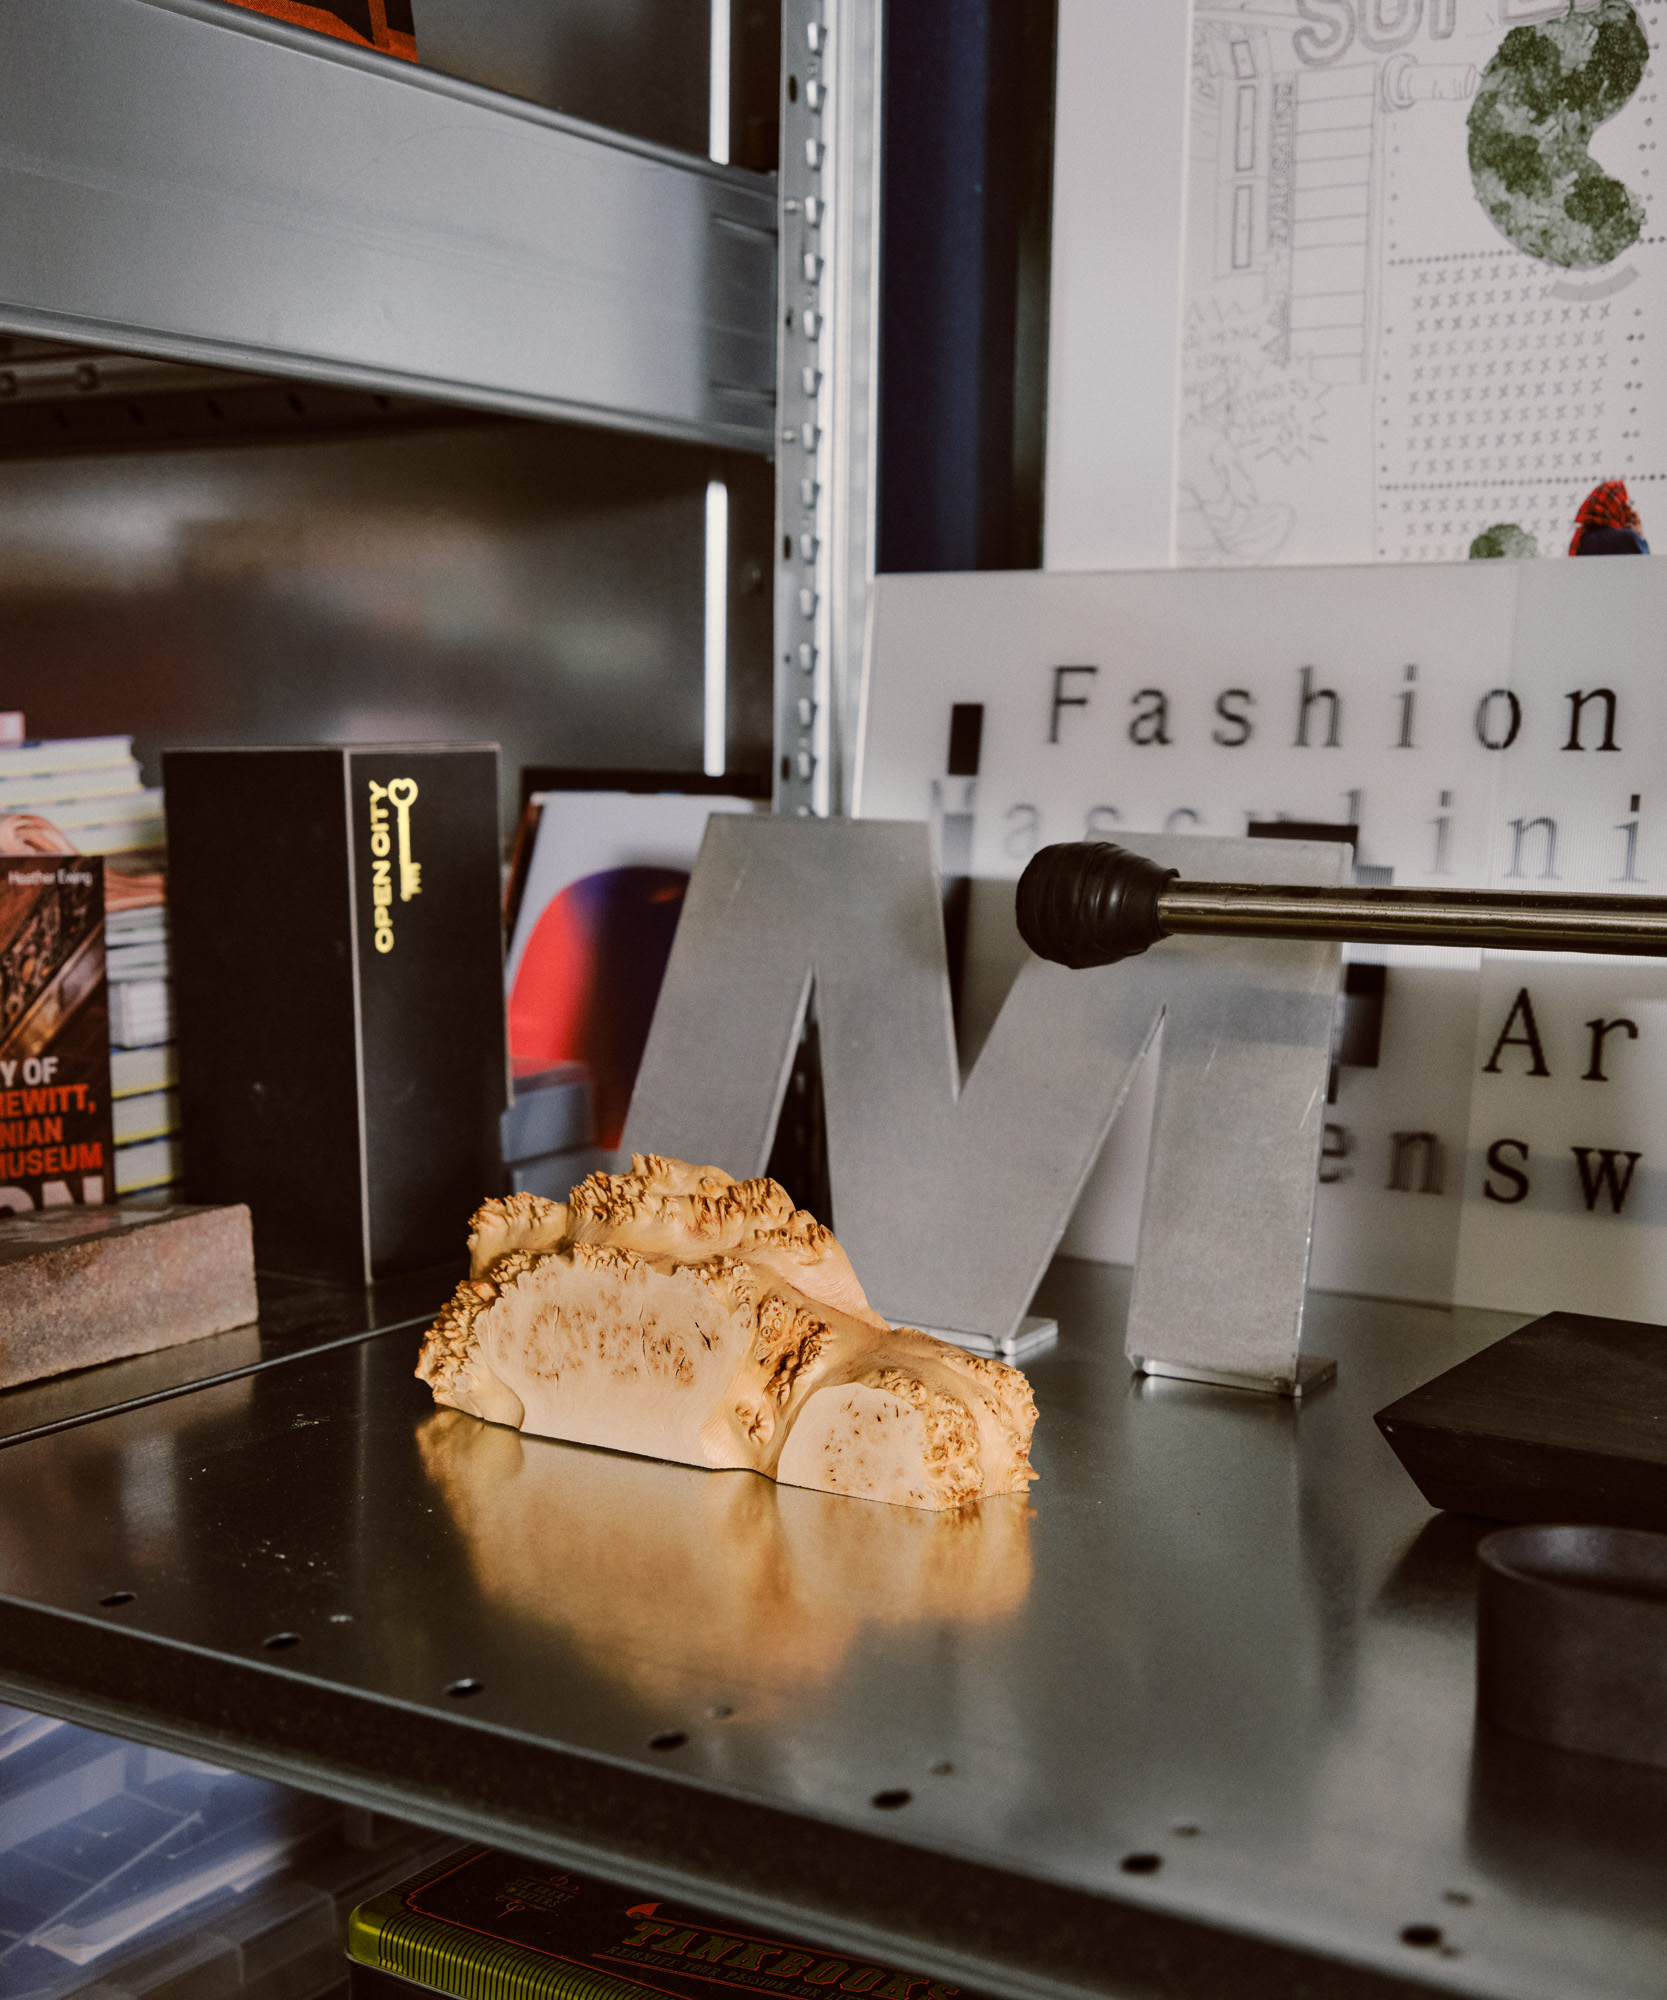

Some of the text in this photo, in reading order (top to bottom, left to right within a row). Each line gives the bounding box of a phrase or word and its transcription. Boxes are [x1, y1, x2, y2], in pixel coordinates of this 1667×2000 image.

[1050, 664, 1622, 752] Fashion
[8, 868, 92, 887] Heather Ewing
[369, 779, 395, 953] OPEN CITY
[22, 1056, 58, 1086] OF
[0, 1083, 96, 1117] EWITT,
[0, 1142, 103, 1179] USEUM
[604, 1946, 675, 1968] REIGNITE
[682, 1962, 722, 1976] YOUR
[725, 1969, 790, 1991] PASSION
[790, 1984, 822, 1998] FOR
